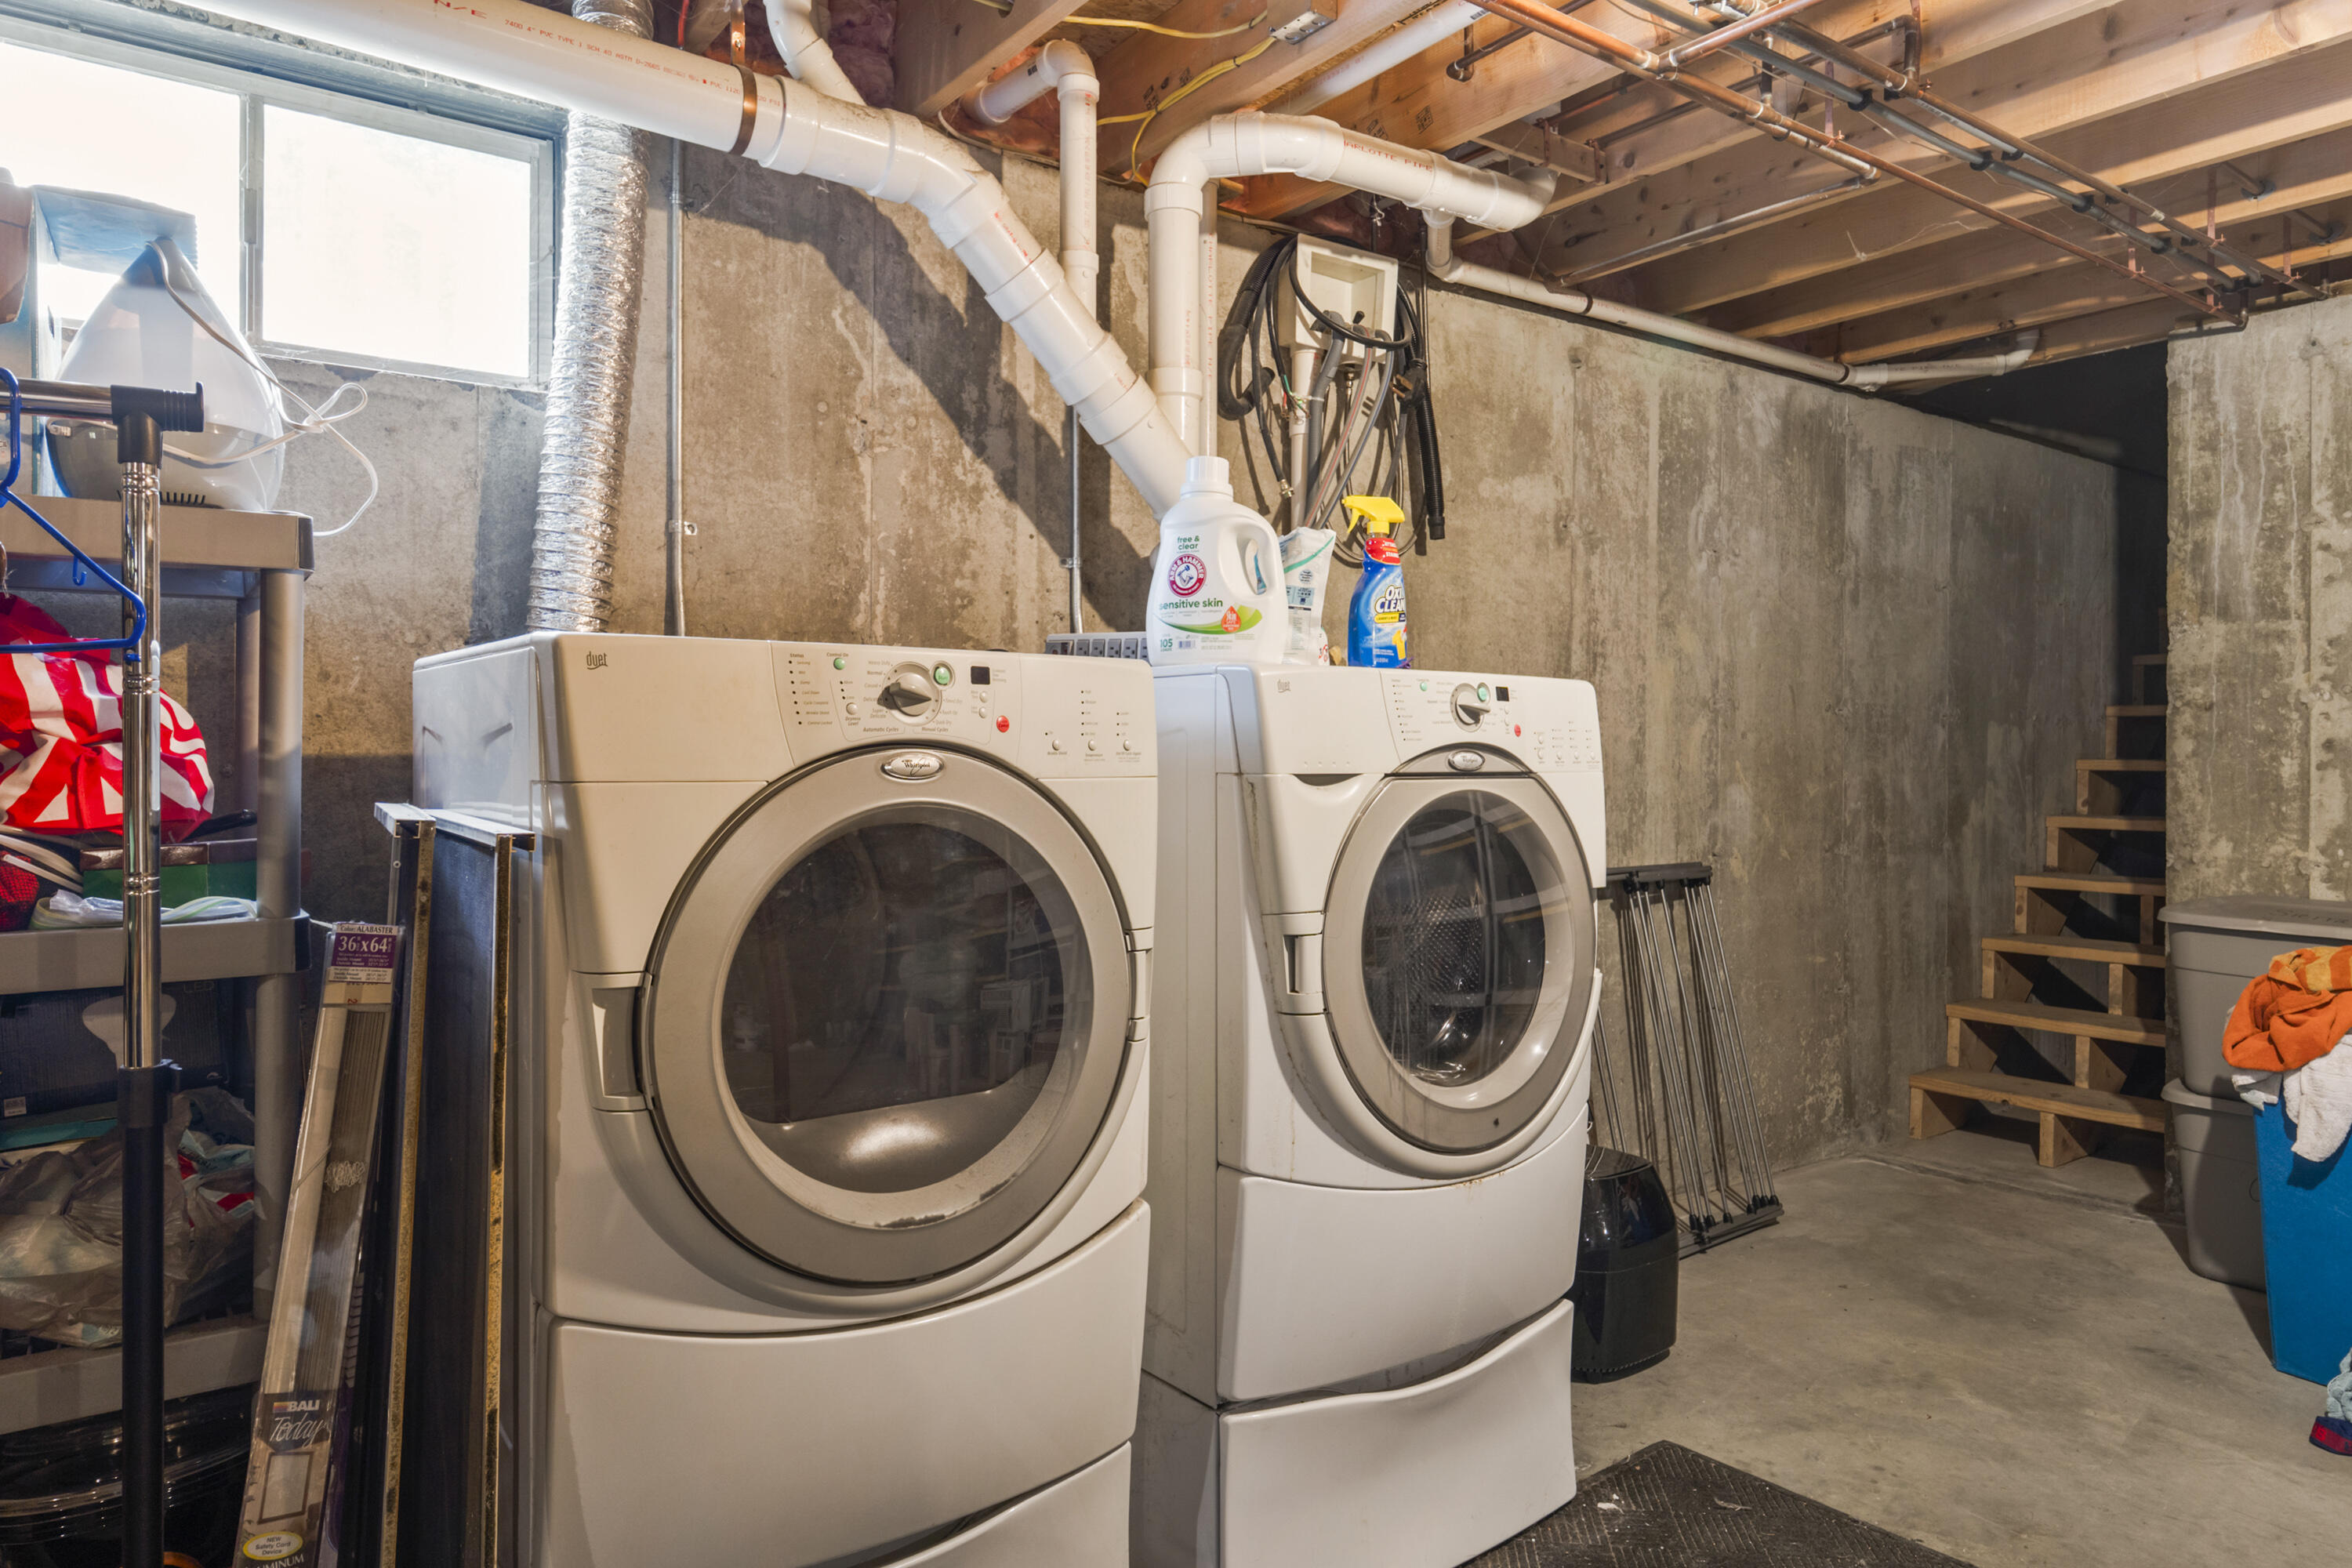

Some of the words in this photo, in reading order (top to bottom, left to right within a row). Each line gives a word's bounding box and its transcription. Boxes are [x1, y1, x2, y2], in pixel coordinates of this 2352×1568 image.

[539, 29, 553, 38] PVC
[1403, 158, 1433, 173] PIPE
[1169, 563, 1179, 581] ARM
[1182, 556, 1205, 579] HAMMER
[1159, 598, 1200, 611] sensitive
[1202, 597, 1223, 608] skin
[1160, 637, 1174, 648] 105
[586, 650, 609, 670] duet
[903, 761, 931, 770] Whirlpool
[357, 925, 393, 934] ALABASTER
[288, 1399, 321, 1412] BALI
